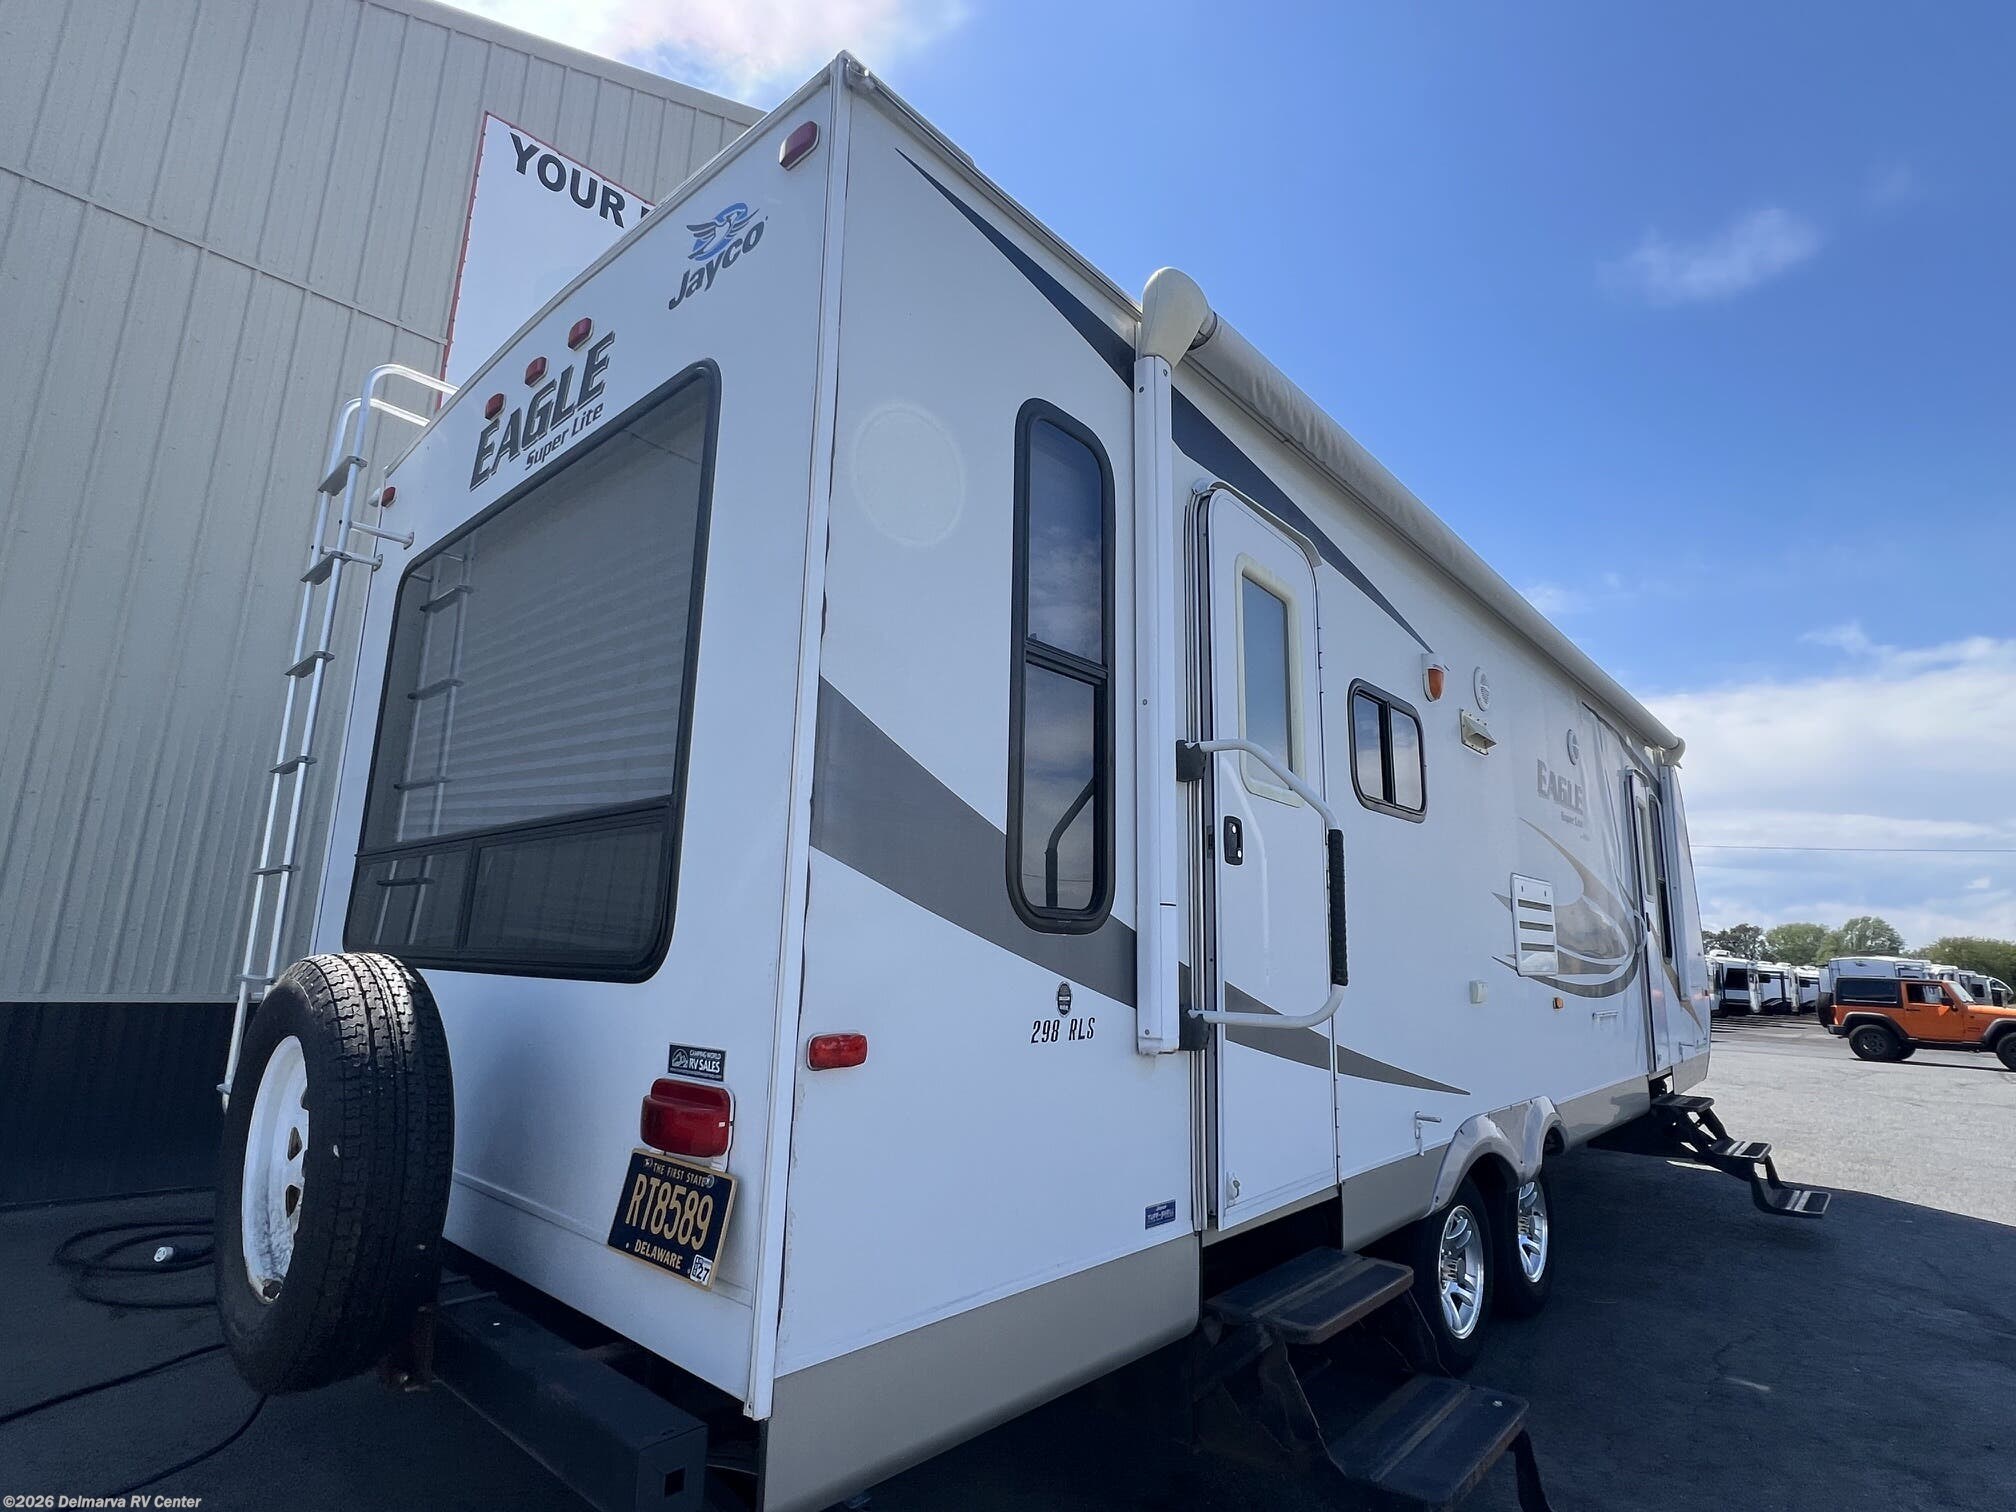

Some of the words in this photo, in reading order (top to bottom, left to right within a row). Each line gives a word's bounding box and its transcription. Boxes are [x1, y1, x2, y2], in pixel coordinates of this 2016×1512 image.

[509, 131, 626, 229] YOUR
[667, 216, 764, 310] Jayco
[470, 330, 615, 491] EAGLE
[524, 431, 570, 471] Super
[571, 403, 604, 440] Lite
[1537, 758, 1583, 815] EAGLE
[1031, 1019, 1060, 1044] 298
[1068, 1017, 1096, 1041] RLS
[688, 1057, 699, 1070] RV
[699, 1059, 720, 1073] SALES
[652, 1162, 665, 1174] THE
[667, 1166, 684, 1181] FIRST
[686, 1173, 705, 1187] STATE
[625, 1172, 713, 1251] RT8589
[634, 1238, 684, 1270] DELAWARE
